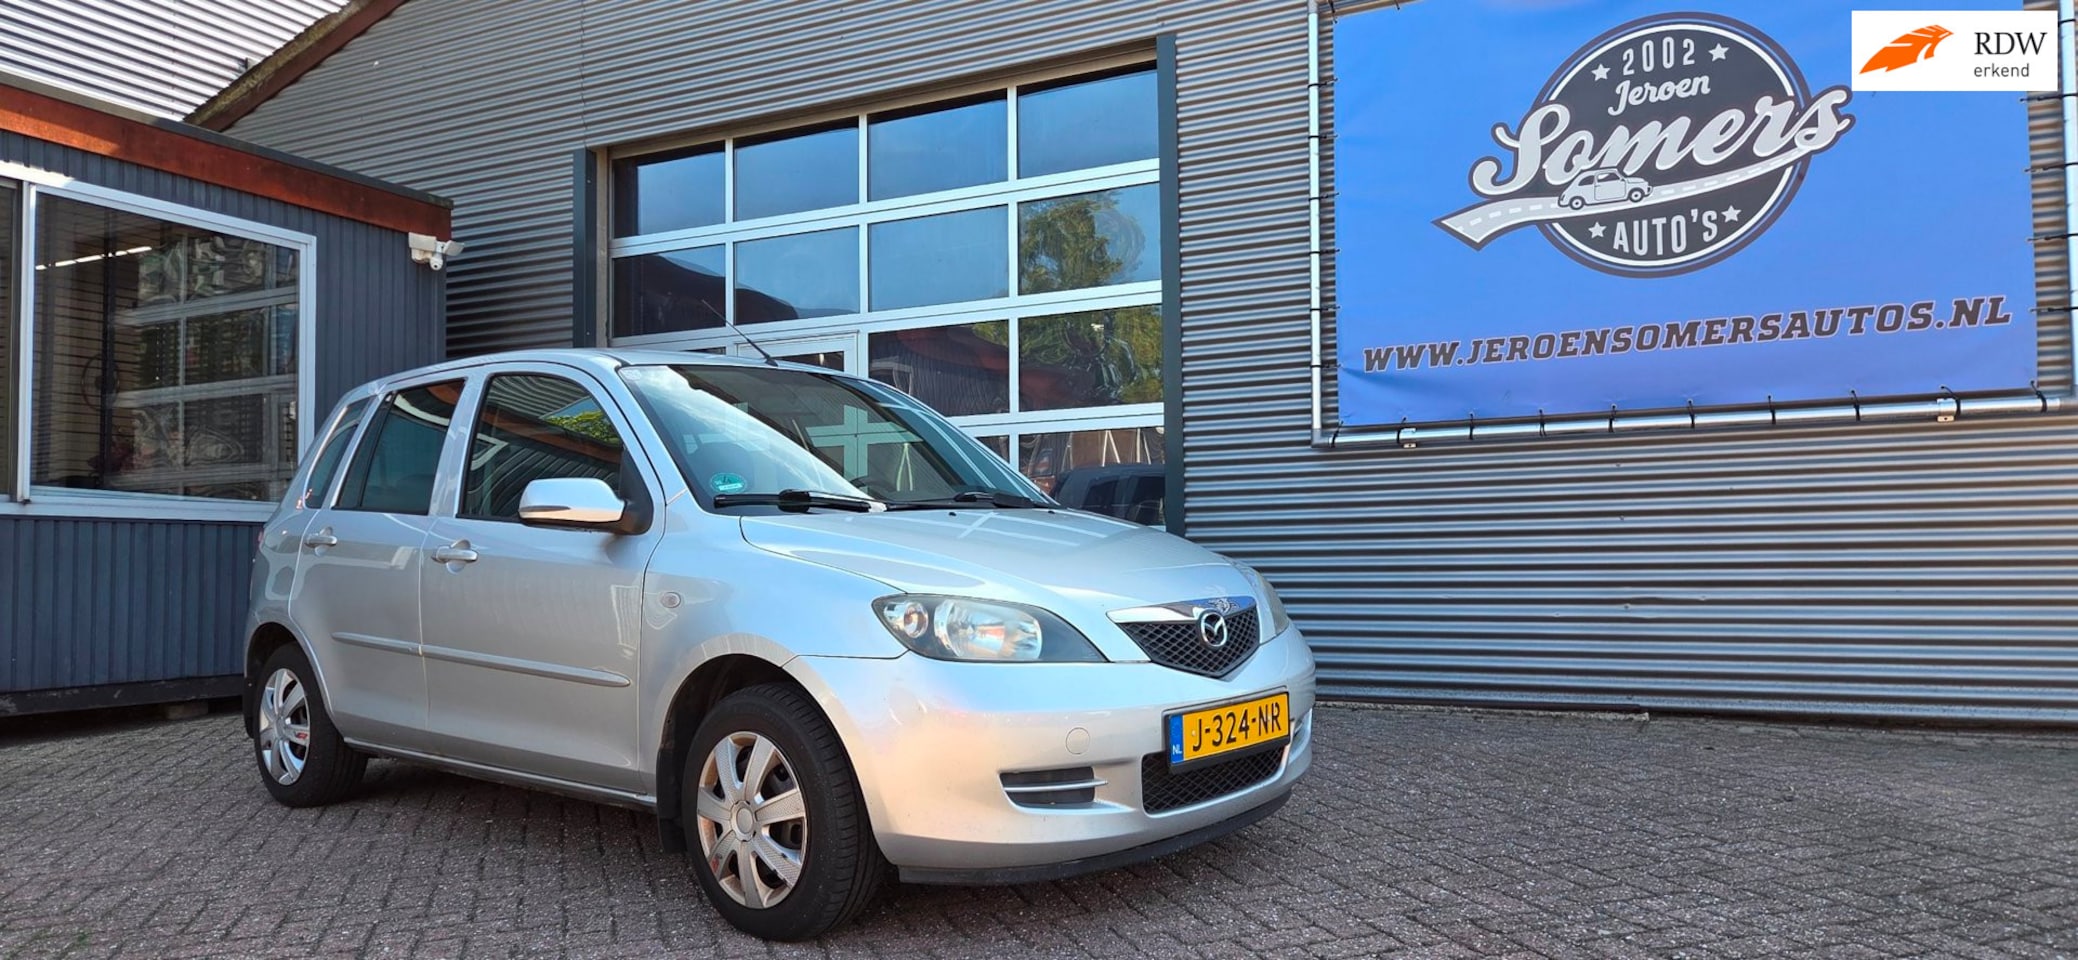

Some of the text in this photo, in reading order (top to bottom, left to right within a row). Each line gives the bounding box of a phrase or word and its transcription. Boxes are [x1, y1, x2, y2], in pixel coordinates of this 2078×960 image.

[1622, 36, 1696, 75] 2002
[1608, 74, 1711, 116] Jeroen
[1472, 89, 1851, 196] Somers
[1613, 209, 1719, 256] AUTO'S
[1363, 295, 2012, 373] WWW.JEROENSOMERSAUTOS.NL
[1172, 744, 1182, 755] NL
[1192, 702, 1282, 752] J-324-NR
